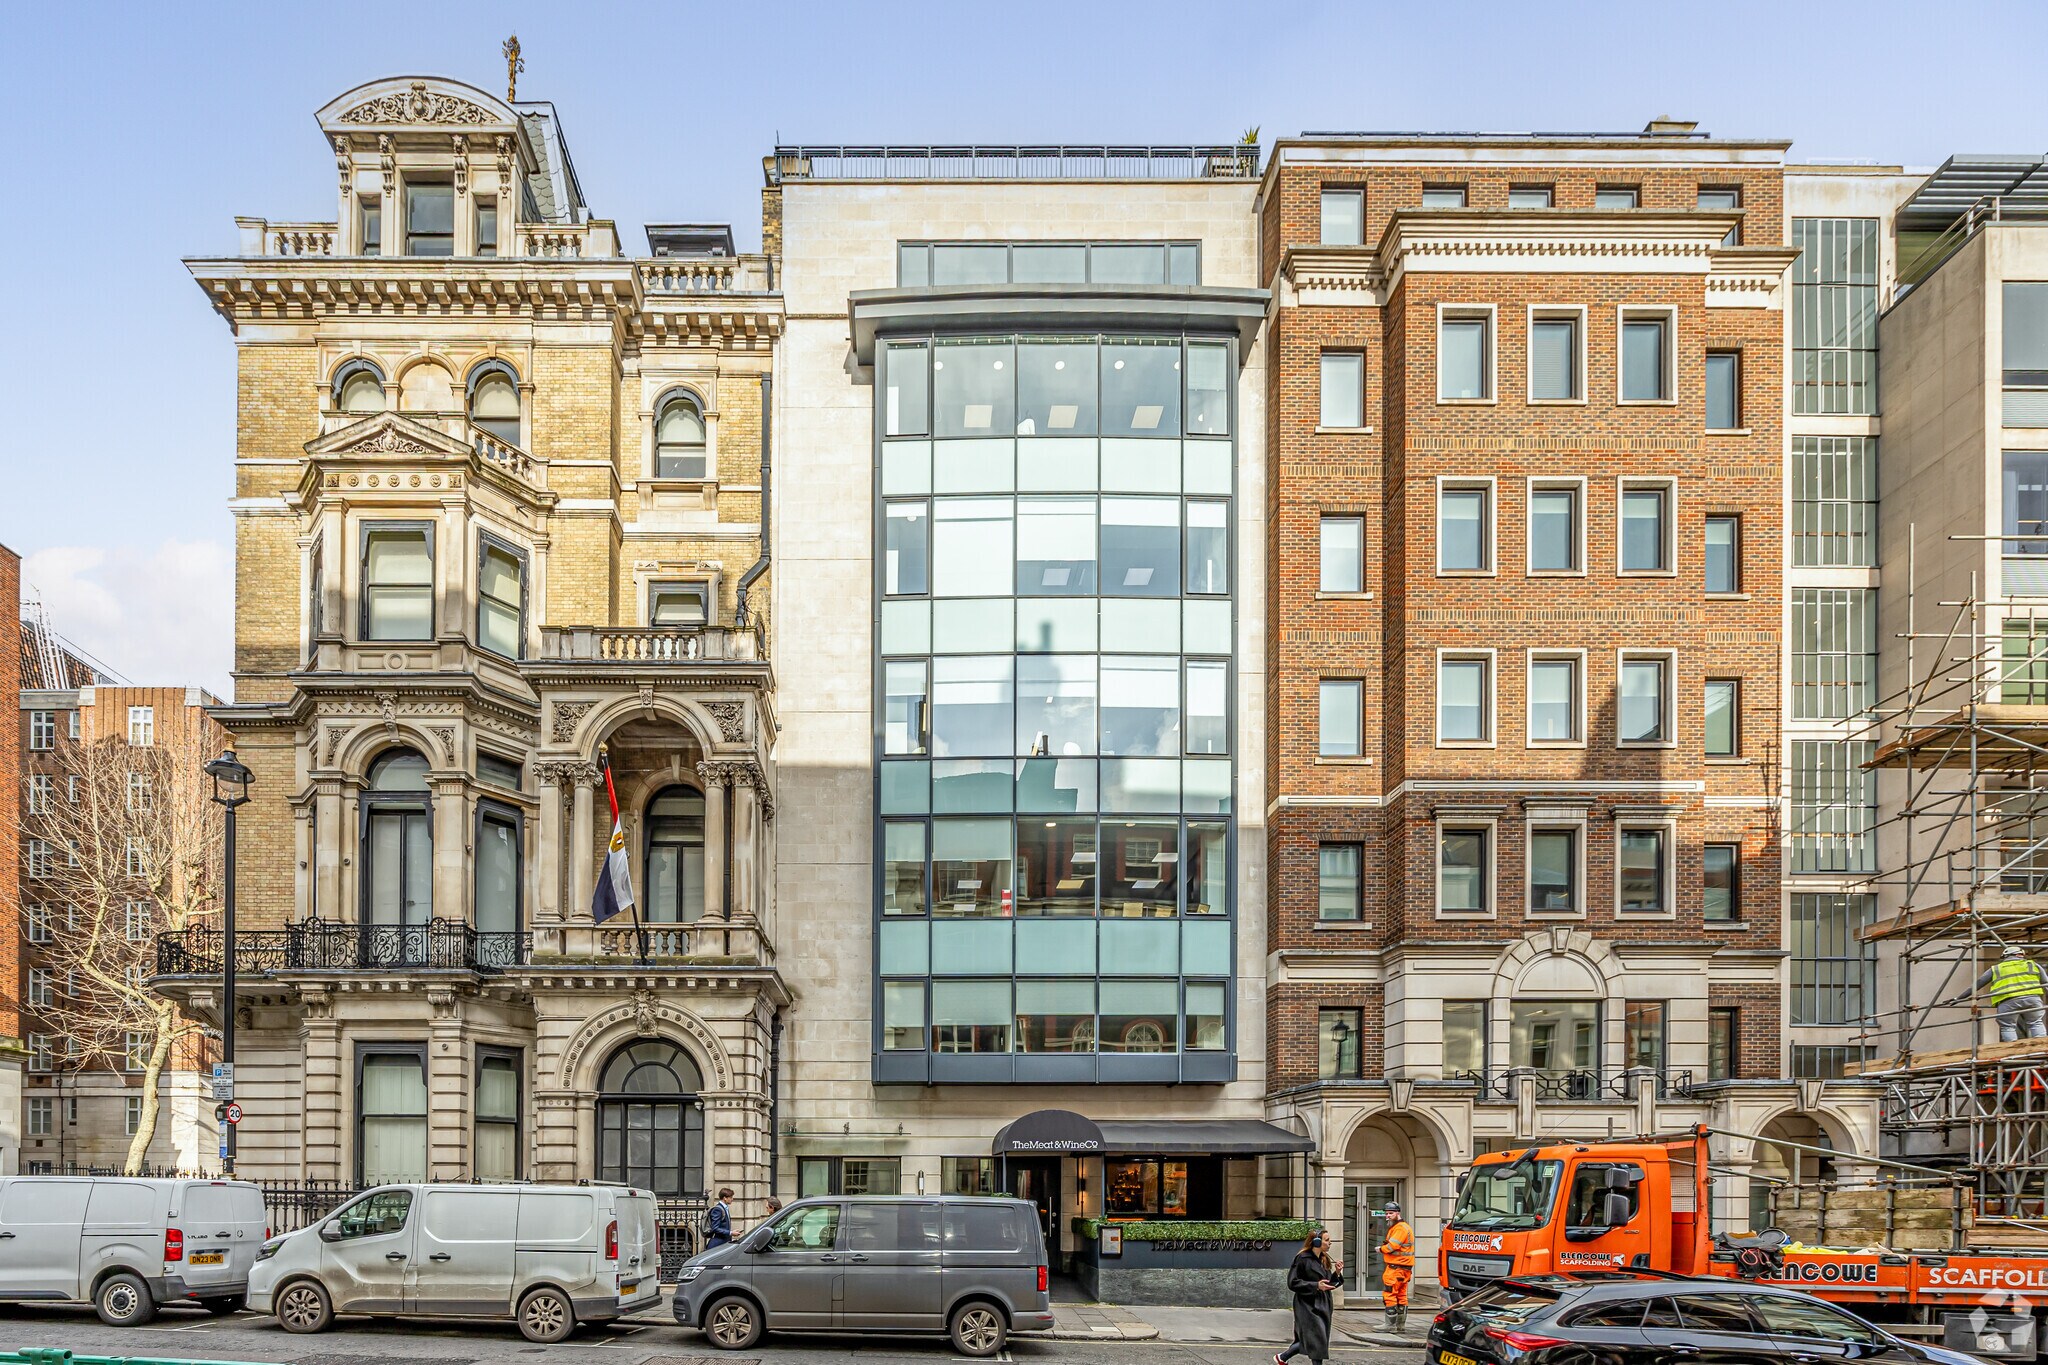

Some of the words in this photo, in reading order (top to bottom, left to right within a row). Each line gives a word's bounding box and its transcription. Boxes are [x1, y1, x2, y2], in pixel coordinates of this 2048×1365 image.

[230, 1109, 240, 1118] 20
[1453, 1233, 1491, 1243] BLENCOWE
[1452, 1242, 1489, 1251] SCAFFOLDING
[1560, 1252, 1611, 1260] BLENCOWE
[1560, 1259, 1611, 1267] SCAFFOLDING
[1462, 1264, 1486, 1273] DAF
[1759, 1261, 1878, 1282] ENCOWE
